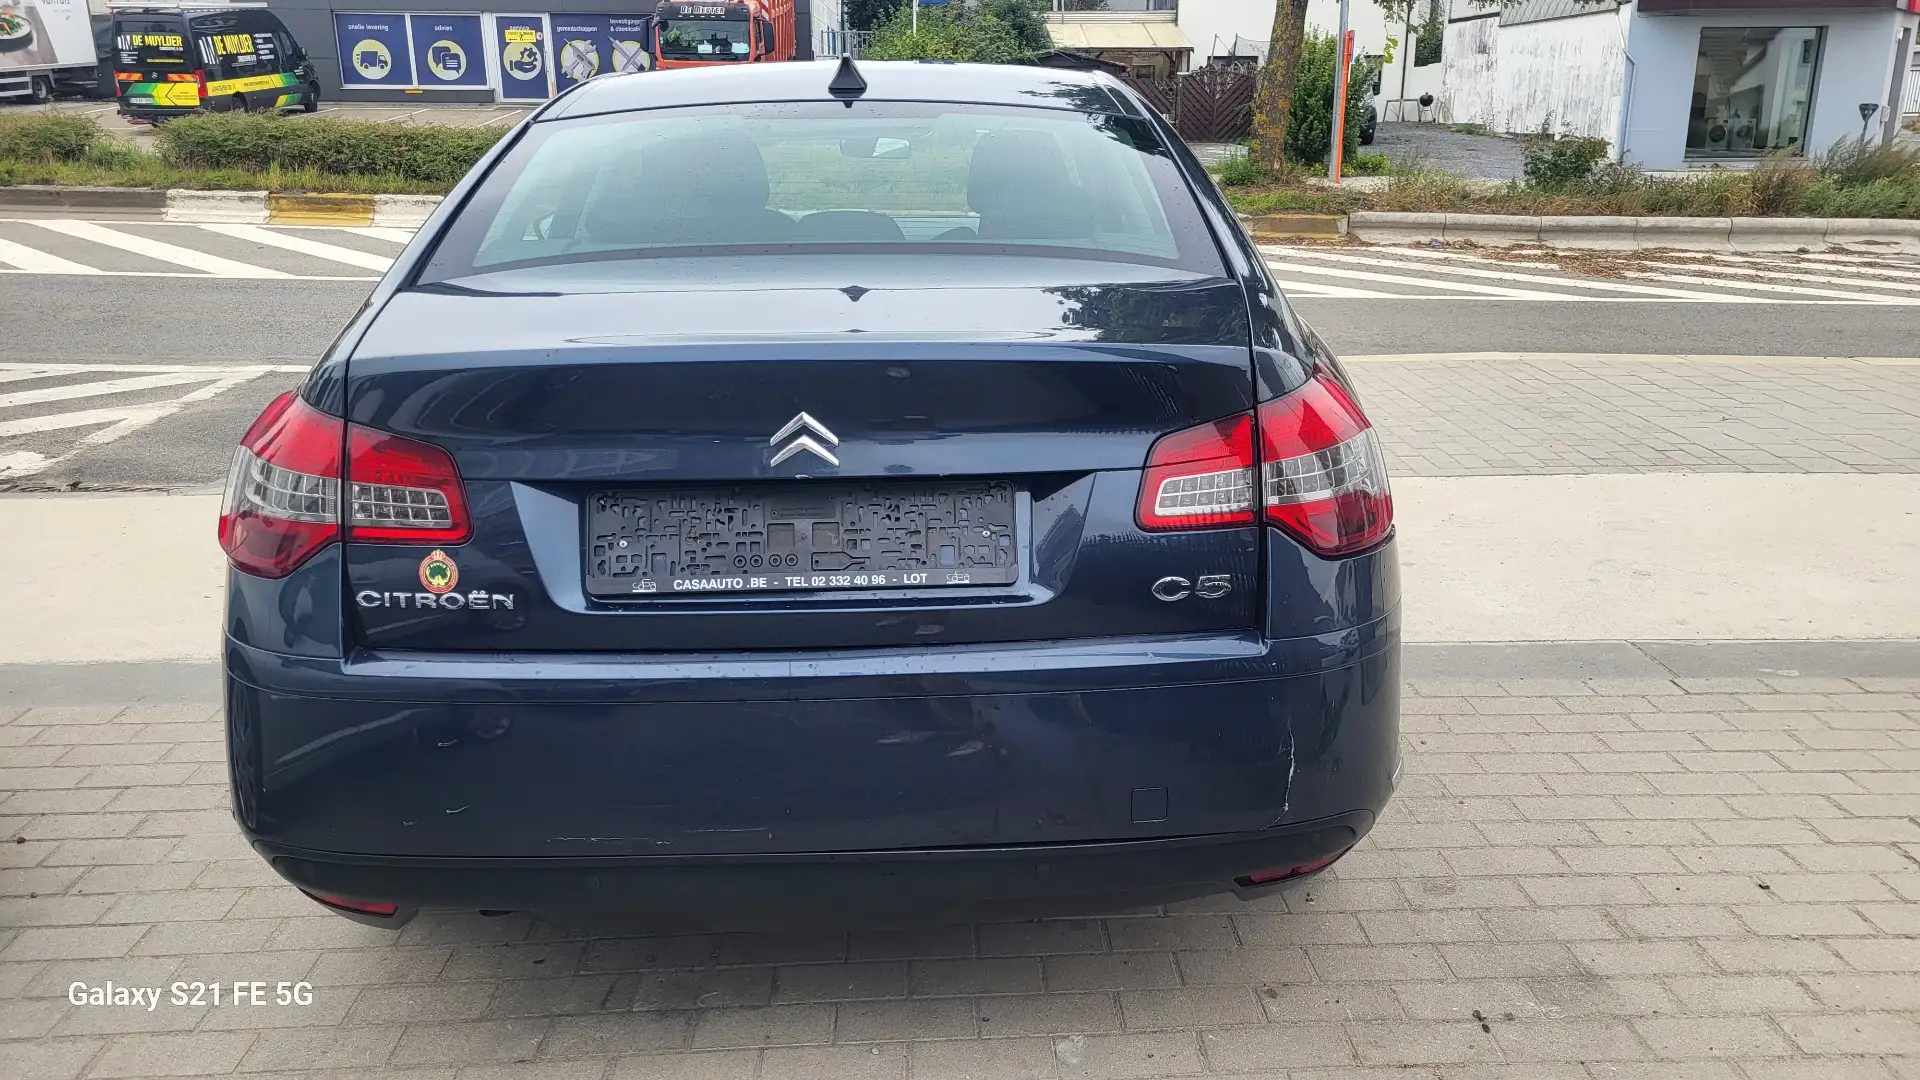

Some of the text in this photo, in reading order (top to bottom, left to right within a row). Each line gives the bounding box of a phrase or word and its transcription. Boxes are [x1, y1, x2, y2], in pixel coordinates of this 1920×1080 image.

[132, 35, 183, 47] DE MUYLDER
[213, 35, 226, 55] DE
[223, 34, 255, 54] MUYLDER
[673, 578, 743, 590] CASAAUTO
[785, 576, 809, 587] TEL
[811, 576, 826, 587] 02
[829, 576, 850, 586] 332
[854, 575, 868, 585] 40
[871, 575, 886, 585] 96
[903, 573, 928, 584] LOT
[1151, 574, 1232, 602] C5
[355, 590, 515, 610] CITROËN
